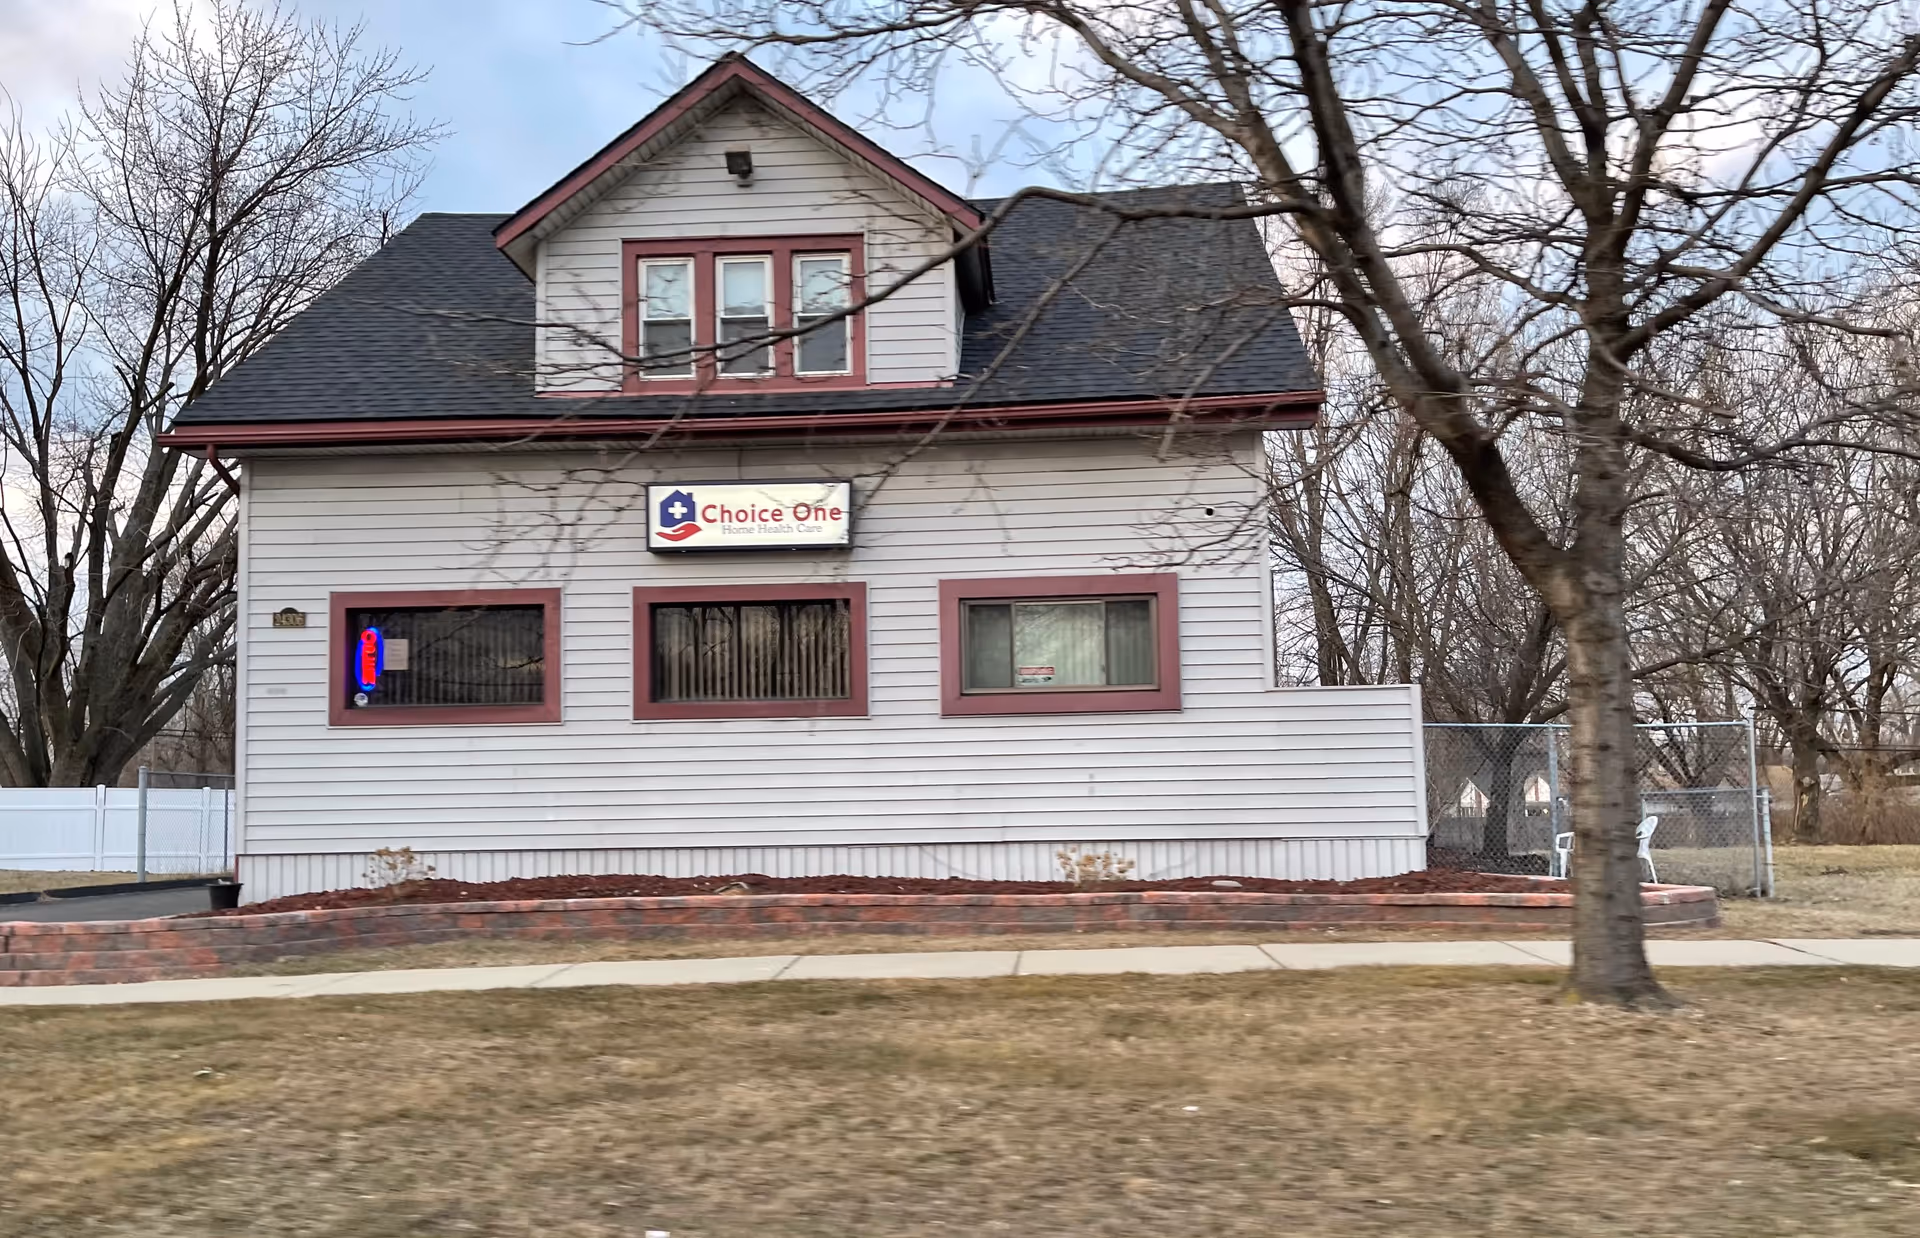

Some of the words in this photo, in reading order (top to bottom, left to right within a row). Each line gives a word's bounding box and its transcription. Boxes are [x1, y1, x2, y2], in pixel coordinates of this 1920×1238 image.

[701, 504, 784, 524] Choice
[793, 502, 843, 522] One
[721, 524, 755, 535] Home
[757, 523, 794, 534] Health
[796, 523, 823, 533] Care
